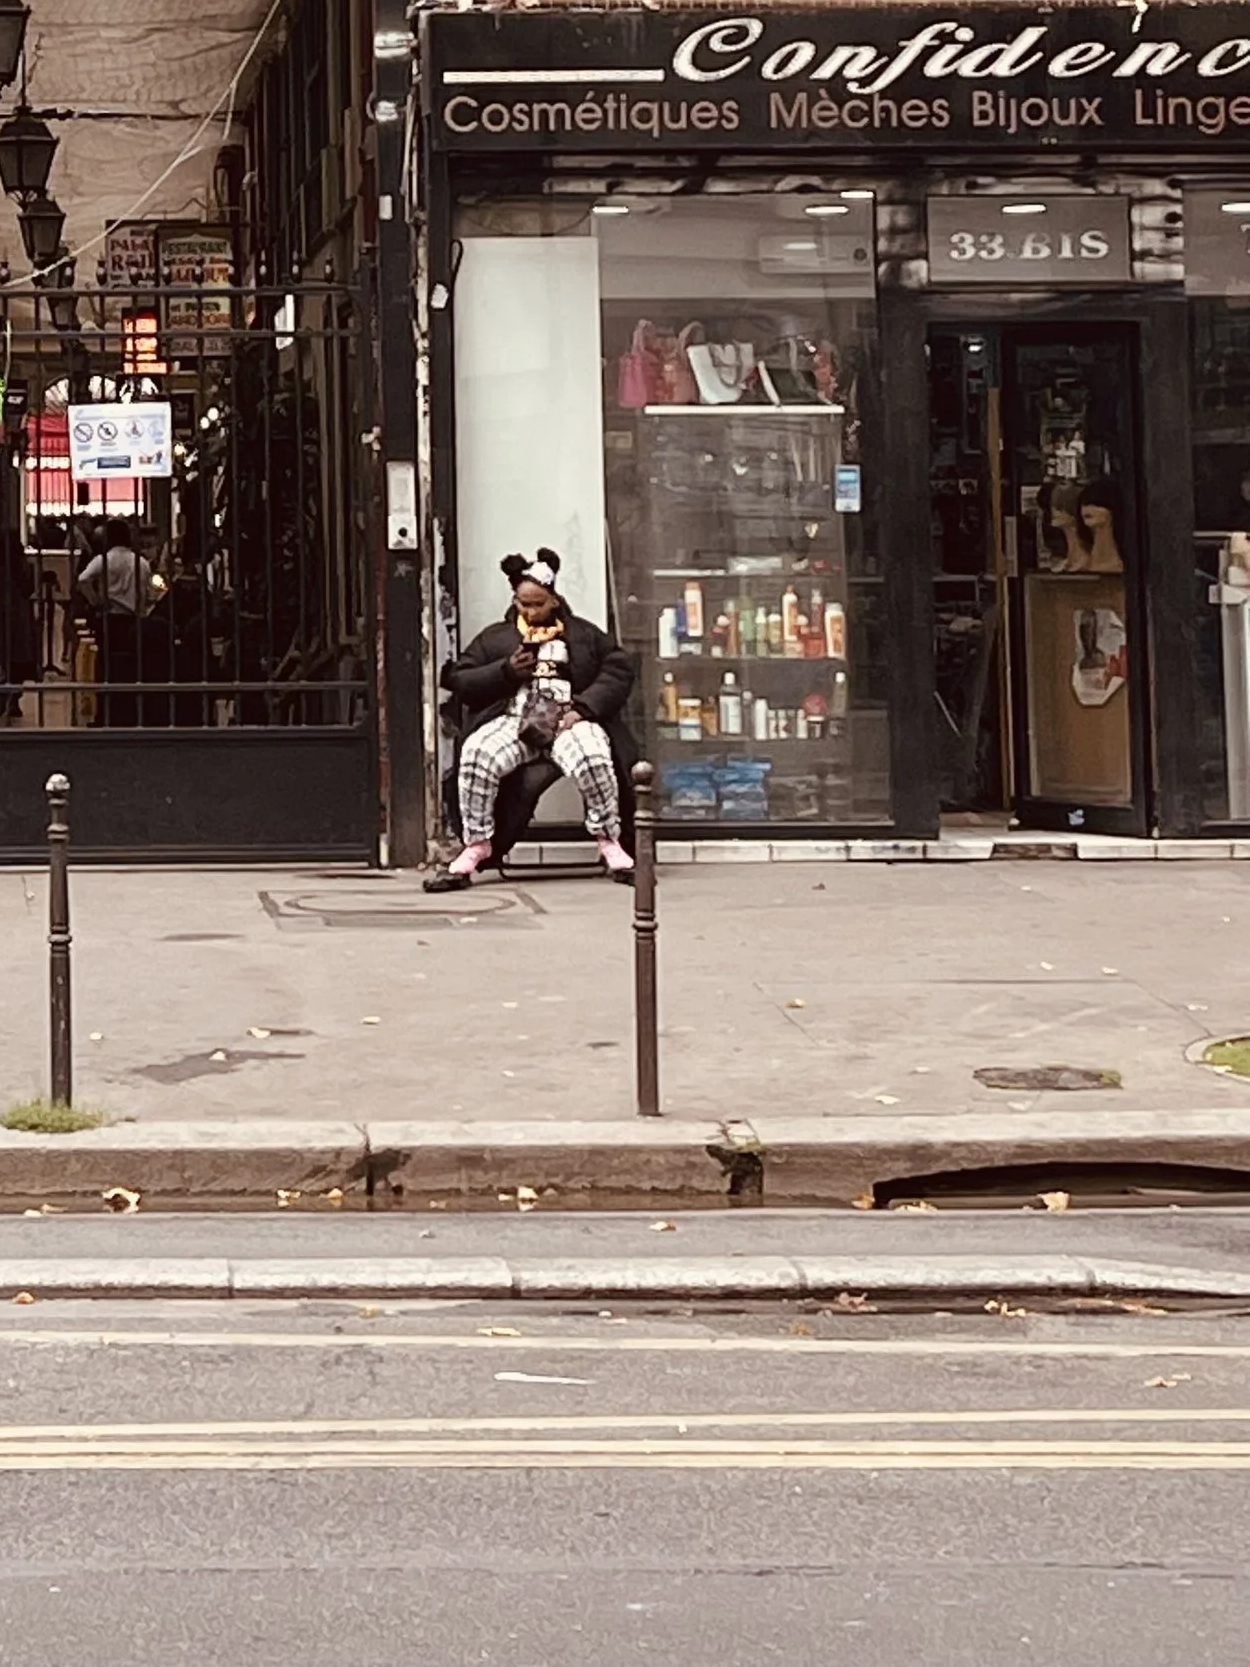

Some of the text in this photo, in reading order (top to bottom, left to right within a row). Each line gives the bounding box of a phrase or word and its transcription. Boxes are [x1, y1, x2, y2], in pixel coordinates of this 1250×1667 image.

[443, 90, 740, 138] Cosmétiques
[768, 87, 950, 130] Mèches
[972, 90, 1104, 134] Bijoux
[1019, 230, 1110, 260] BIS
